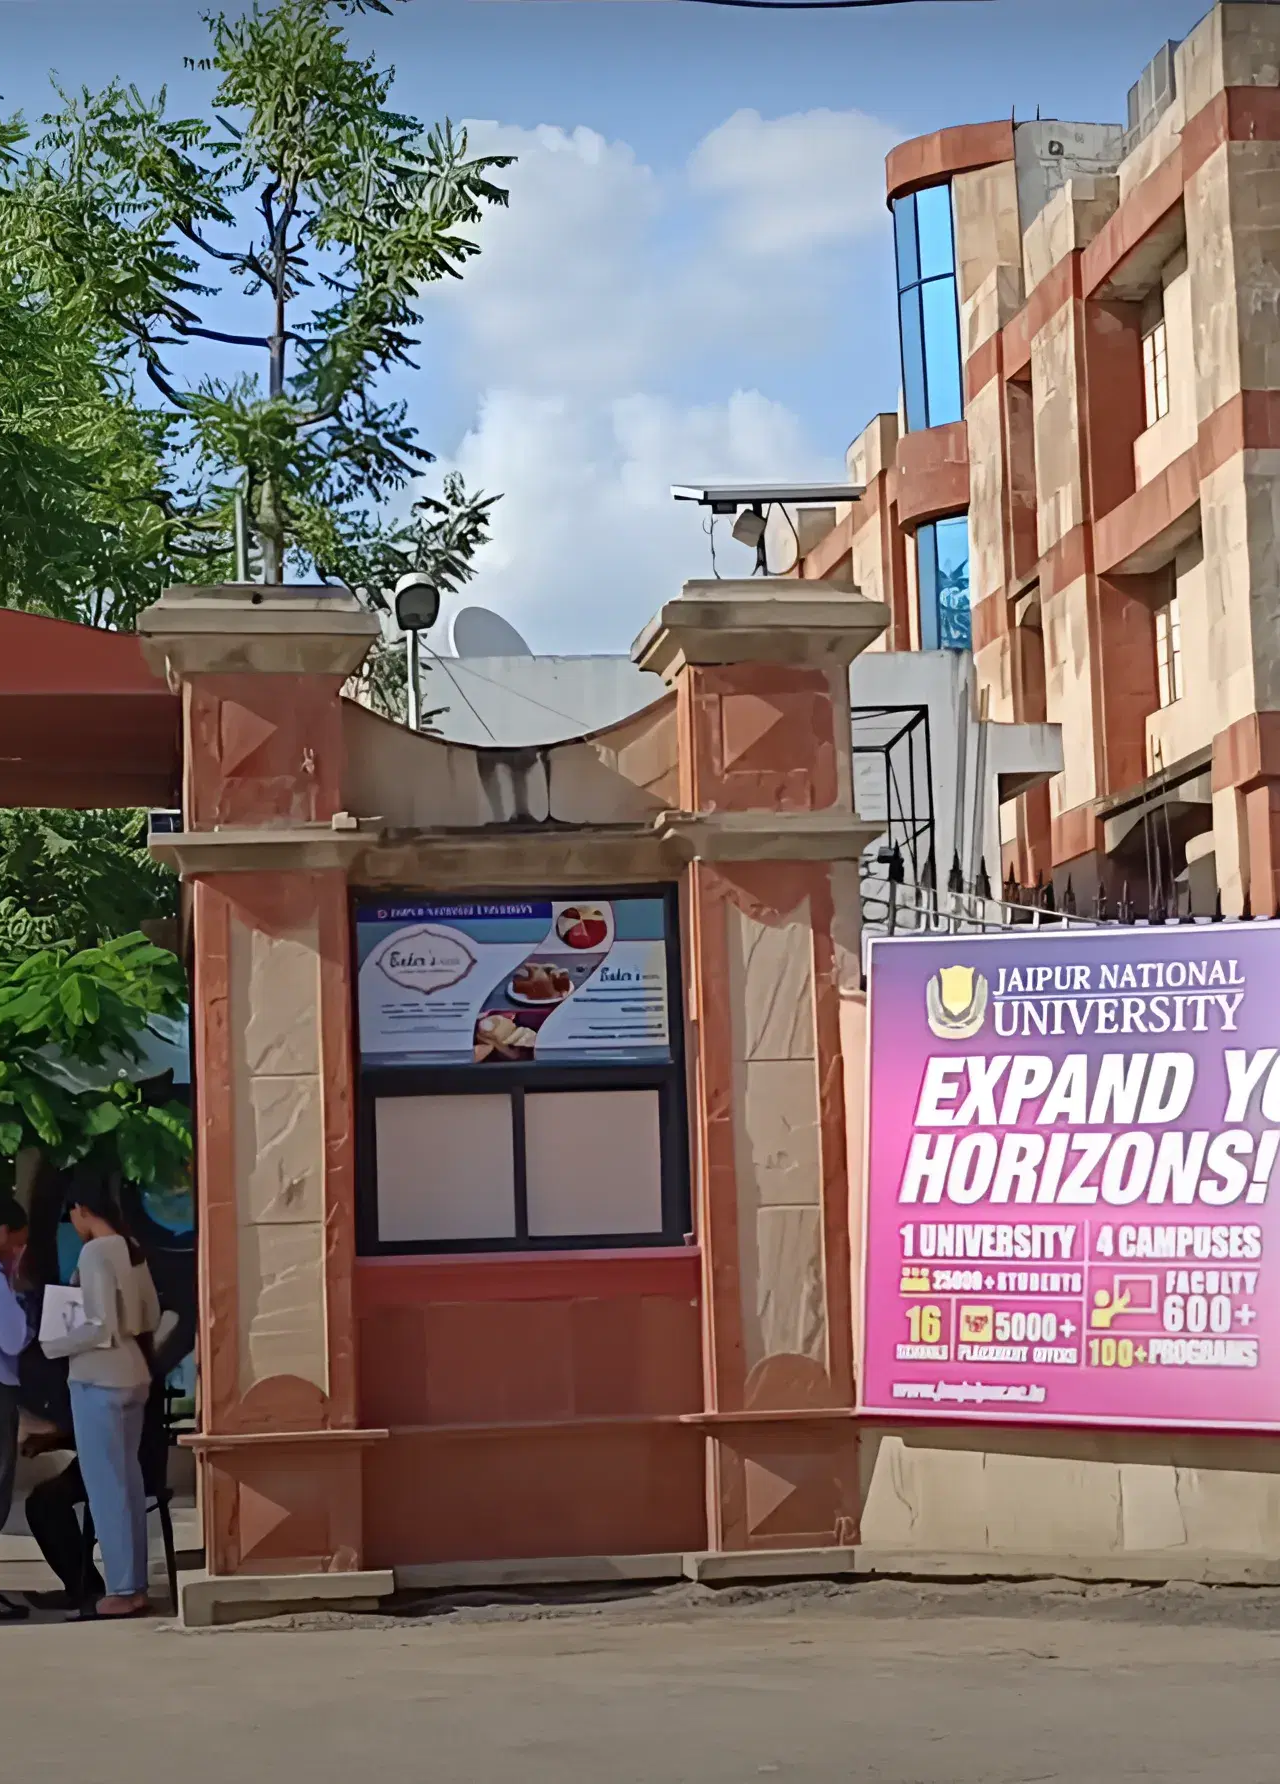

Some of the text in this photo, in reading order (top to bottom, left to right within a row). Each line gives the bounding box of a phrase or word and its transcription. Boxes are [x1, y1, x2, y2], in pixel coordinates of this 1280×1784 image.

[993, 958, 1246, 996] JAIPUR NATIONAL
[993, 993, 1244, 1037] UNIVERSITY
[913, 1051, 1195, 1127] EXPAND
[899, 1223, 1077, 1260] 1 UNIVERSITY
[1096, 1224, 1262, 1259] 4 CAMPUSES
[1165, 1270, 1259, 1295] FACULTY
[905, 1304, 942, 1343] 16
